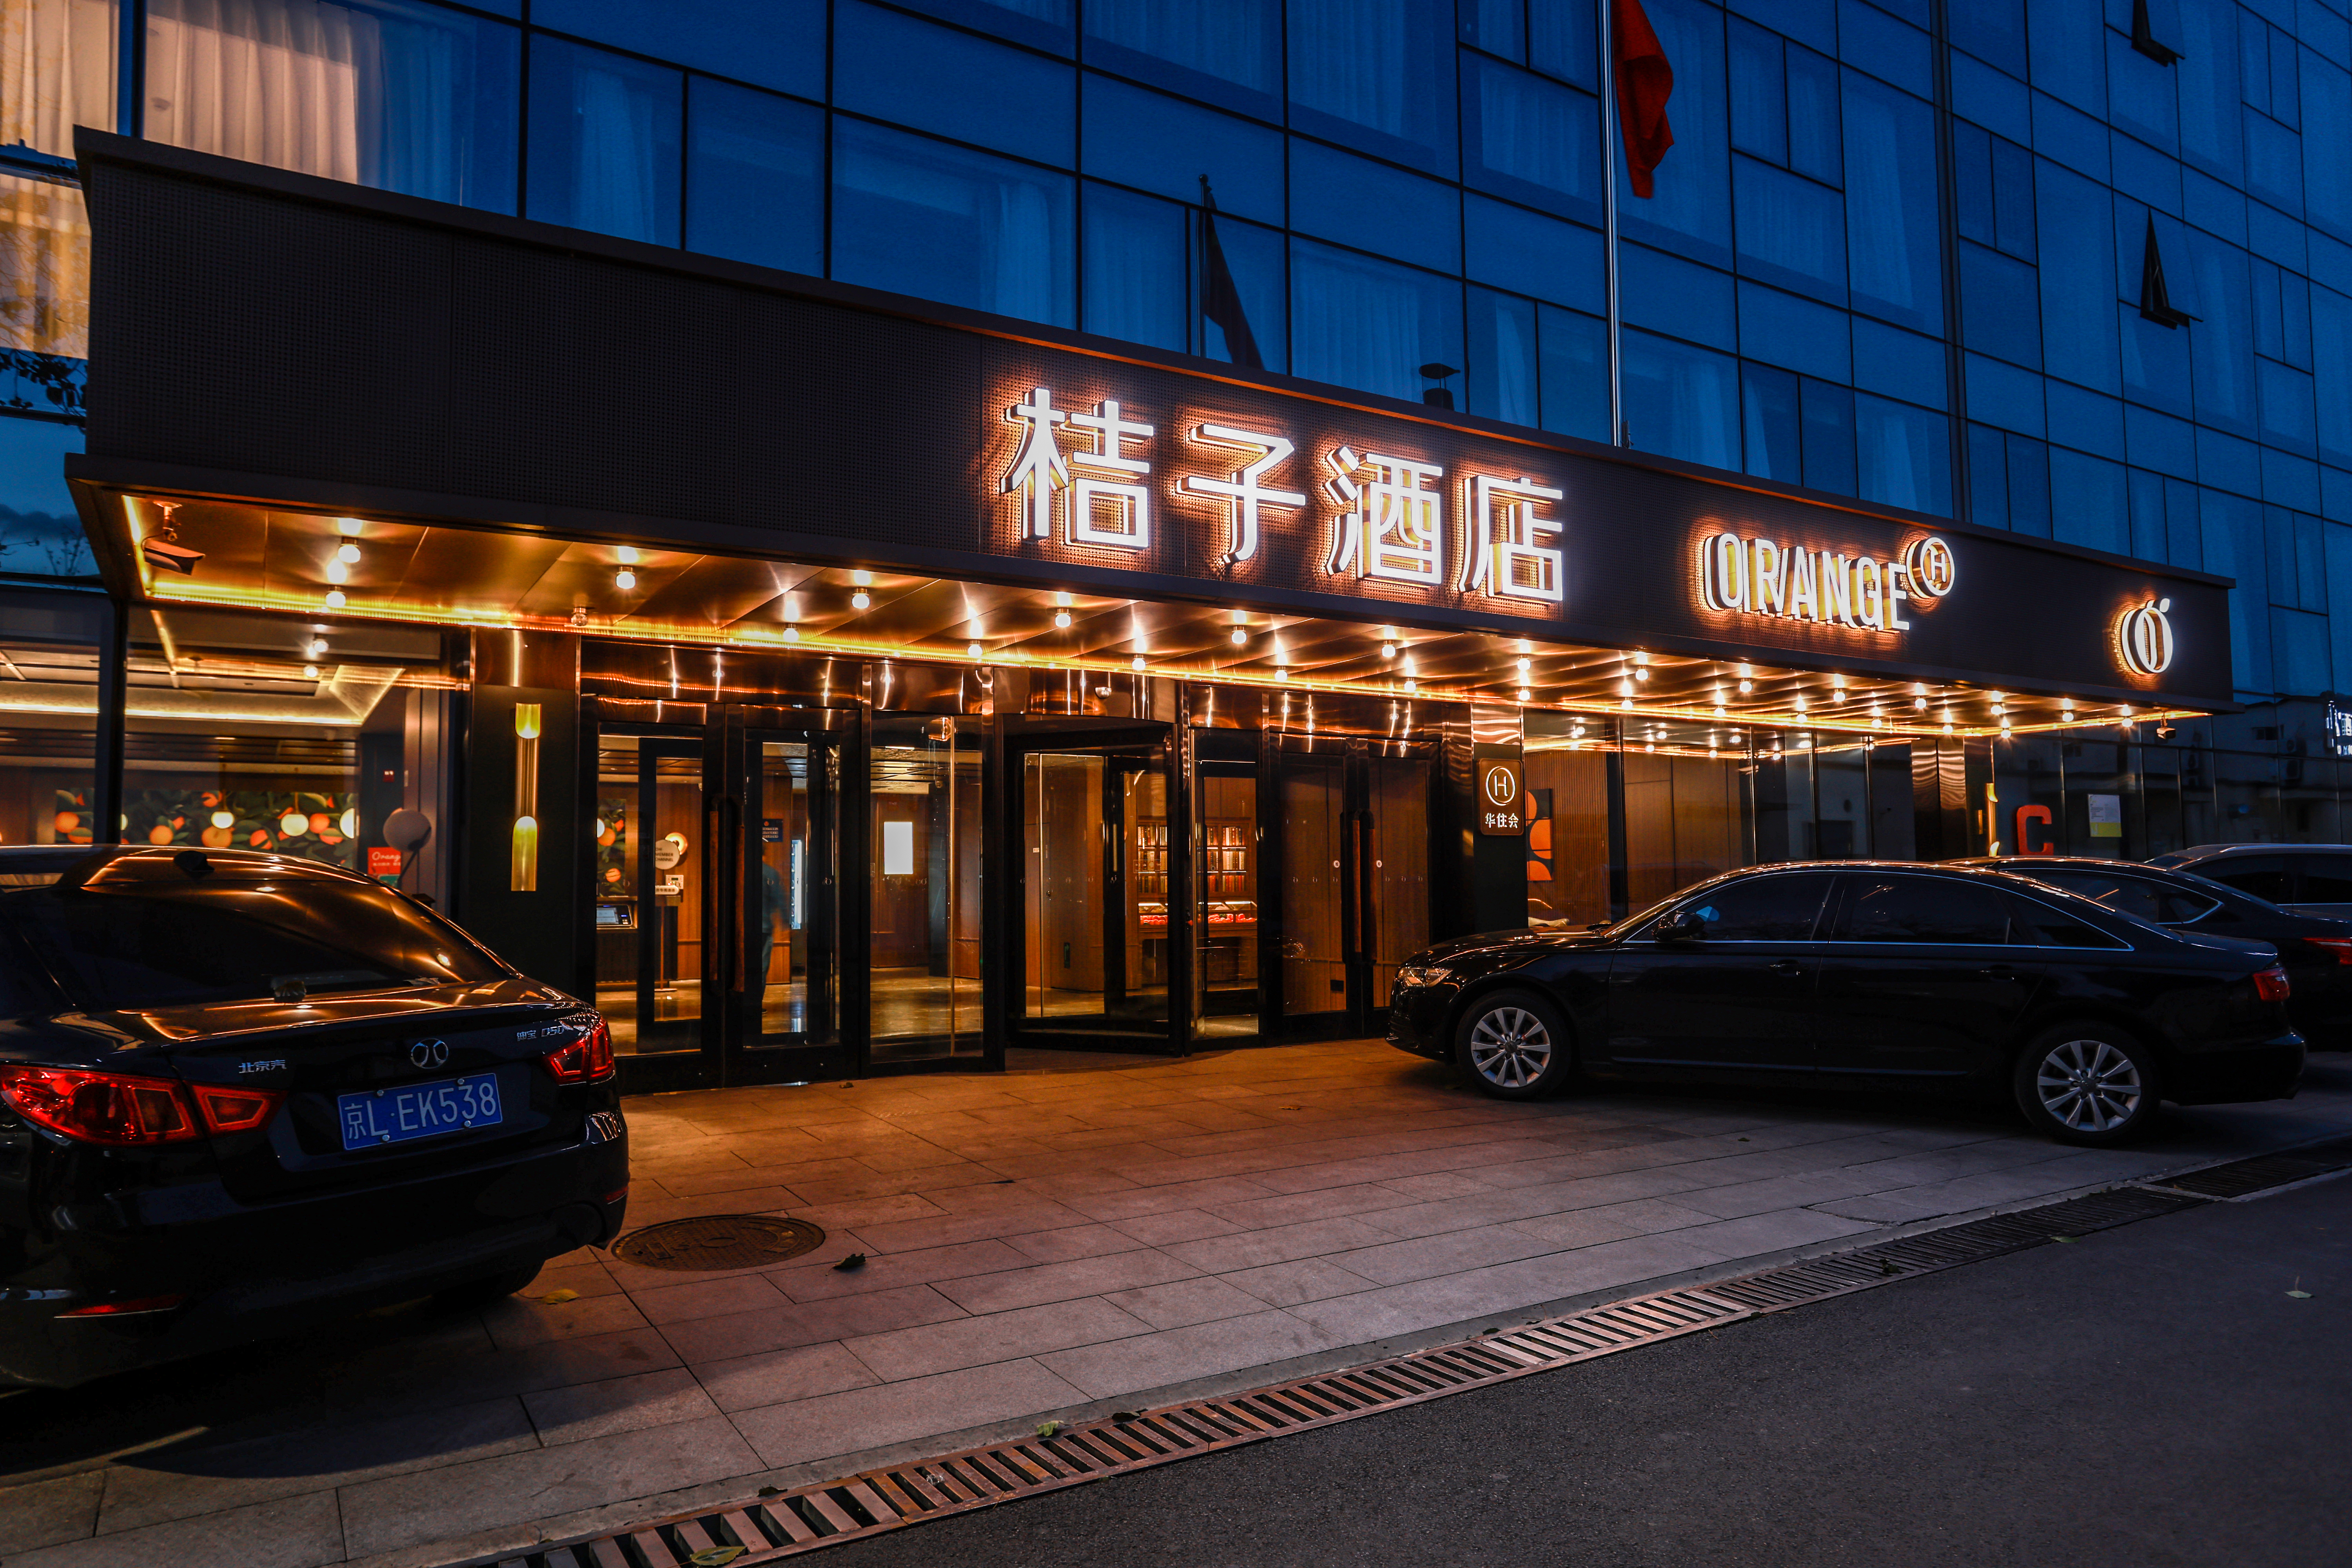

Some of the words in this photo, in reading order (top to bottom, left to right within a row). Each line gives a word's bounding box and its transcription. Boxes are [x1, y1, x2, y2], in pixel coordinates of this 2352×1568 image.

[1000, 387, 1563, 604] 桔子酒店
[1704, 533, 1910, 632] ORANGE
[1485, 813, 1519, 829] 华住会
